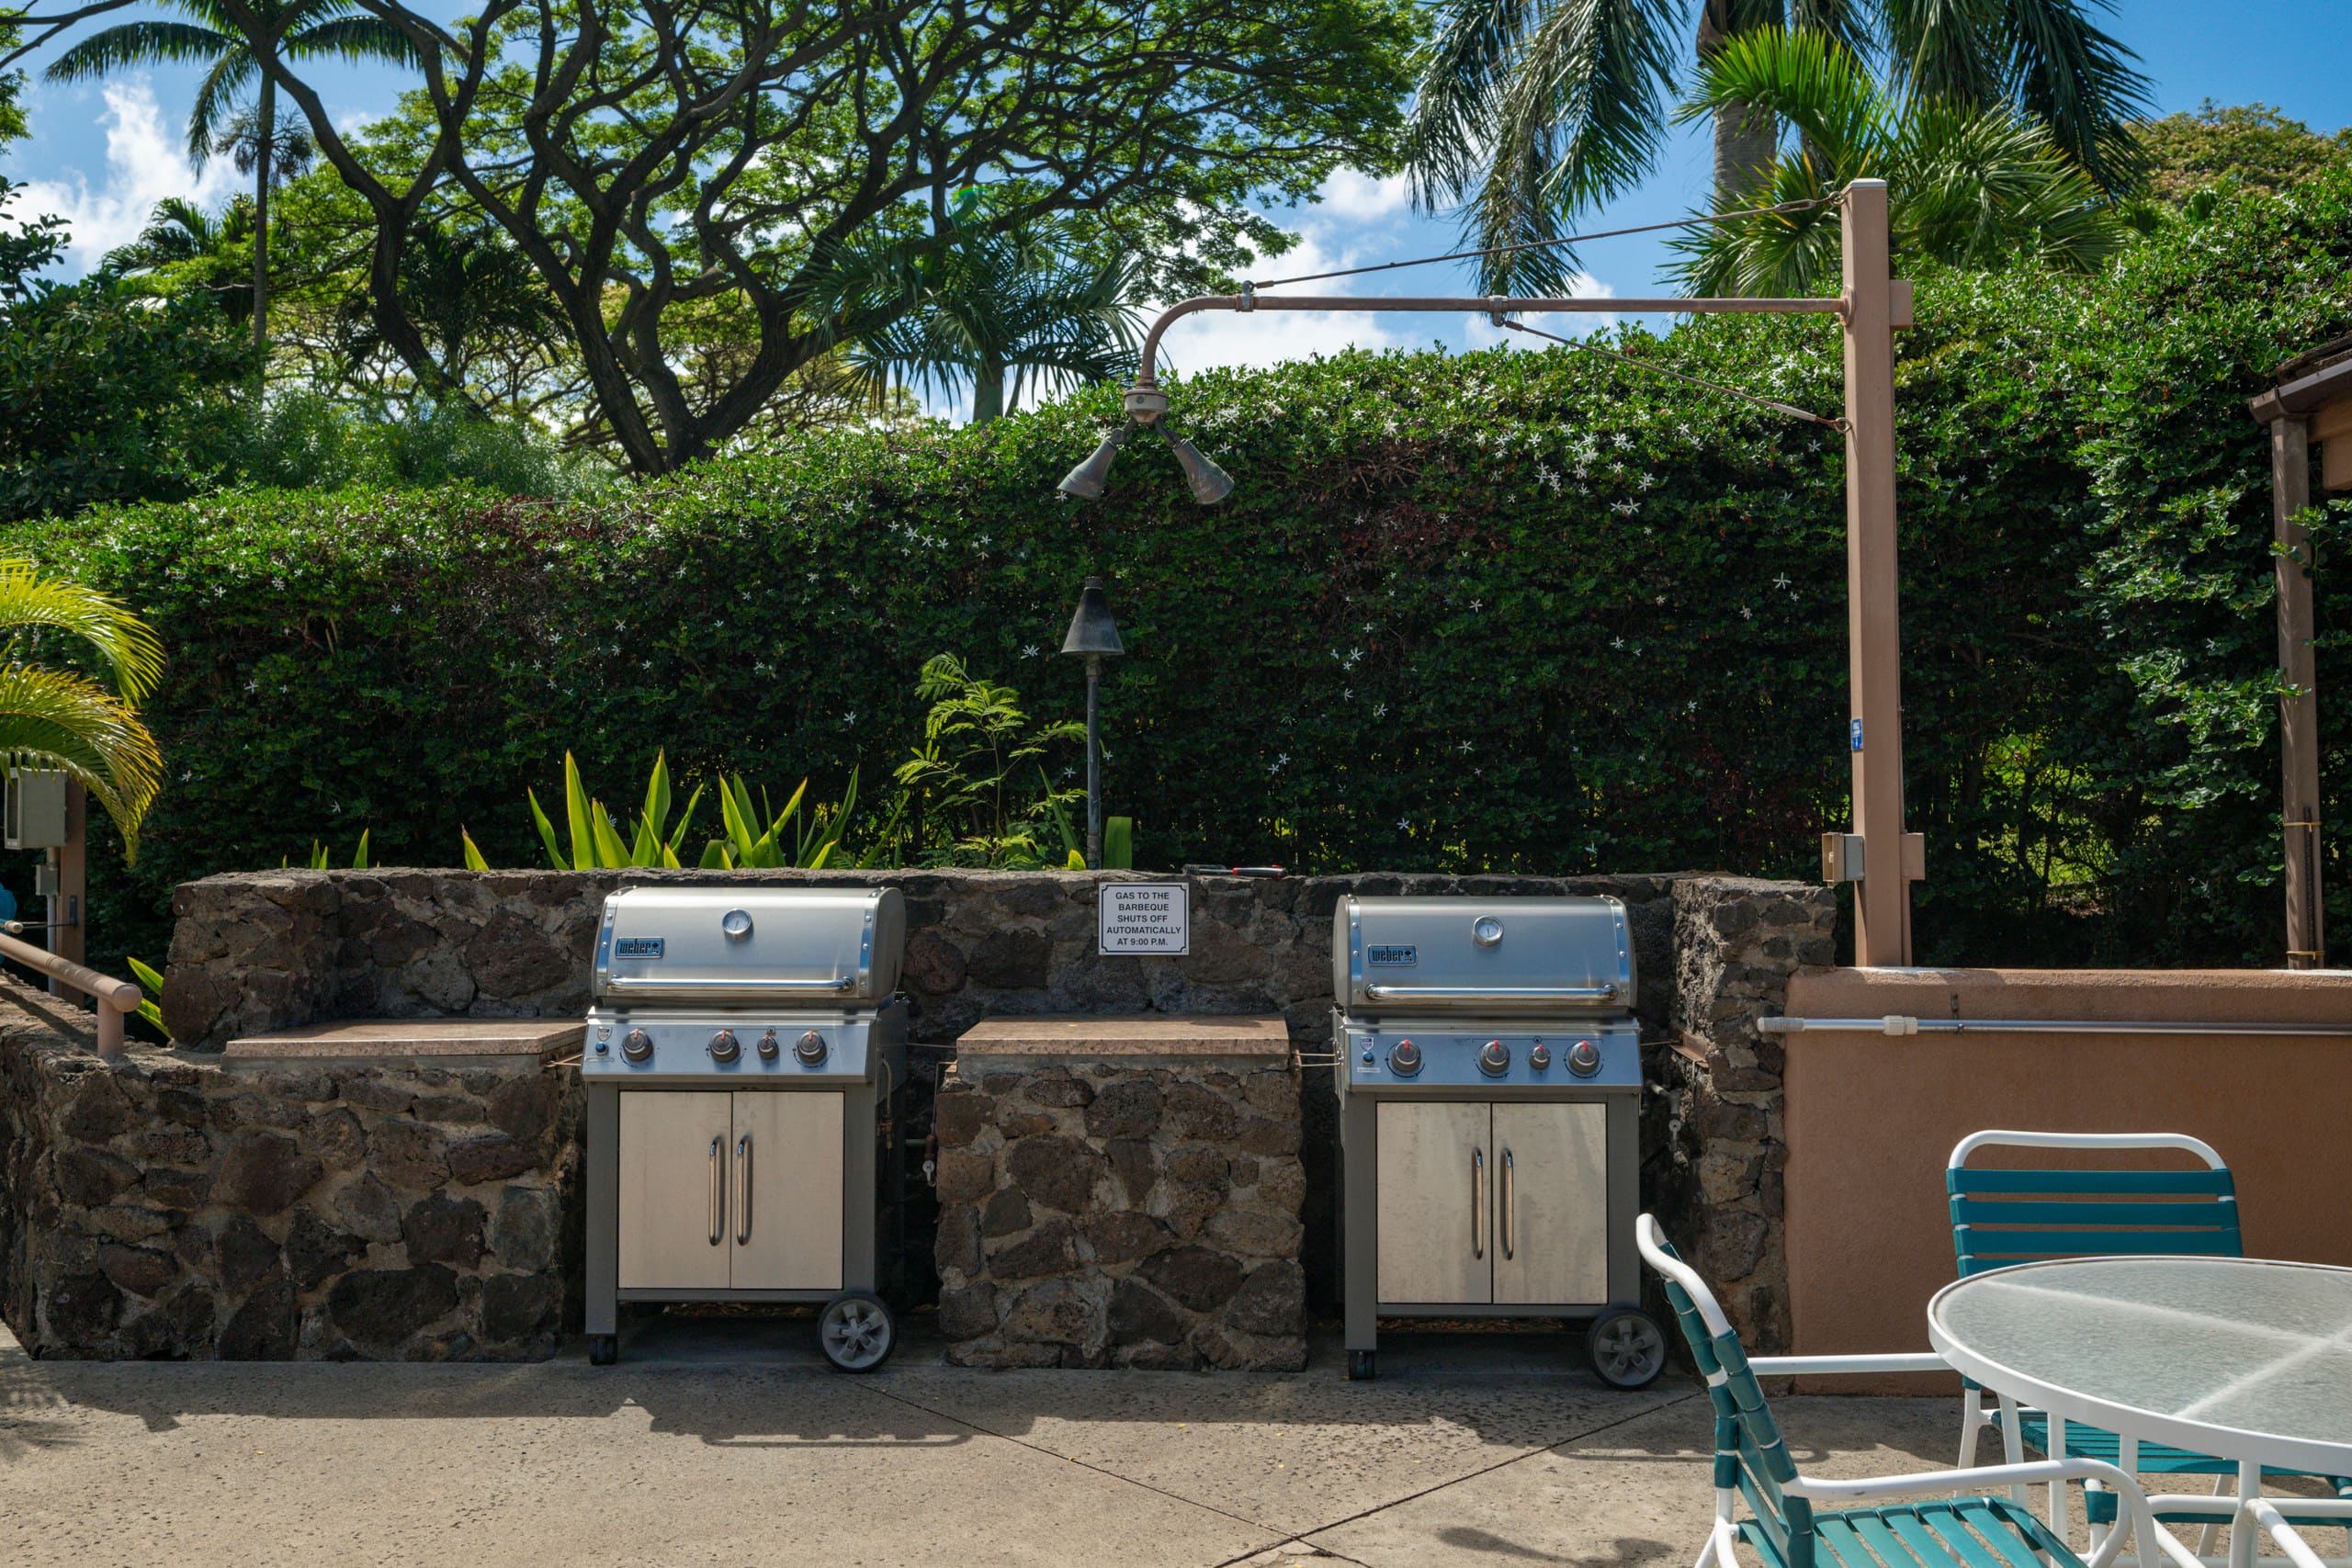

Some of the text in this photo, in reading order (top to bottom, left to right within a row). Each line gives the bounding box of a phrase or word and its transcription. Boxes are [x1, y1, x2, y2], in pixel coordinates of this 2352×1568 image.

[1118, 903, 1170, 911] BARBEQUE
[1106, 926, 1182, 934] AUTOMATICALLY
[619, 939, 651, 953] weber
[1372, 946, 1404, 962] weber
